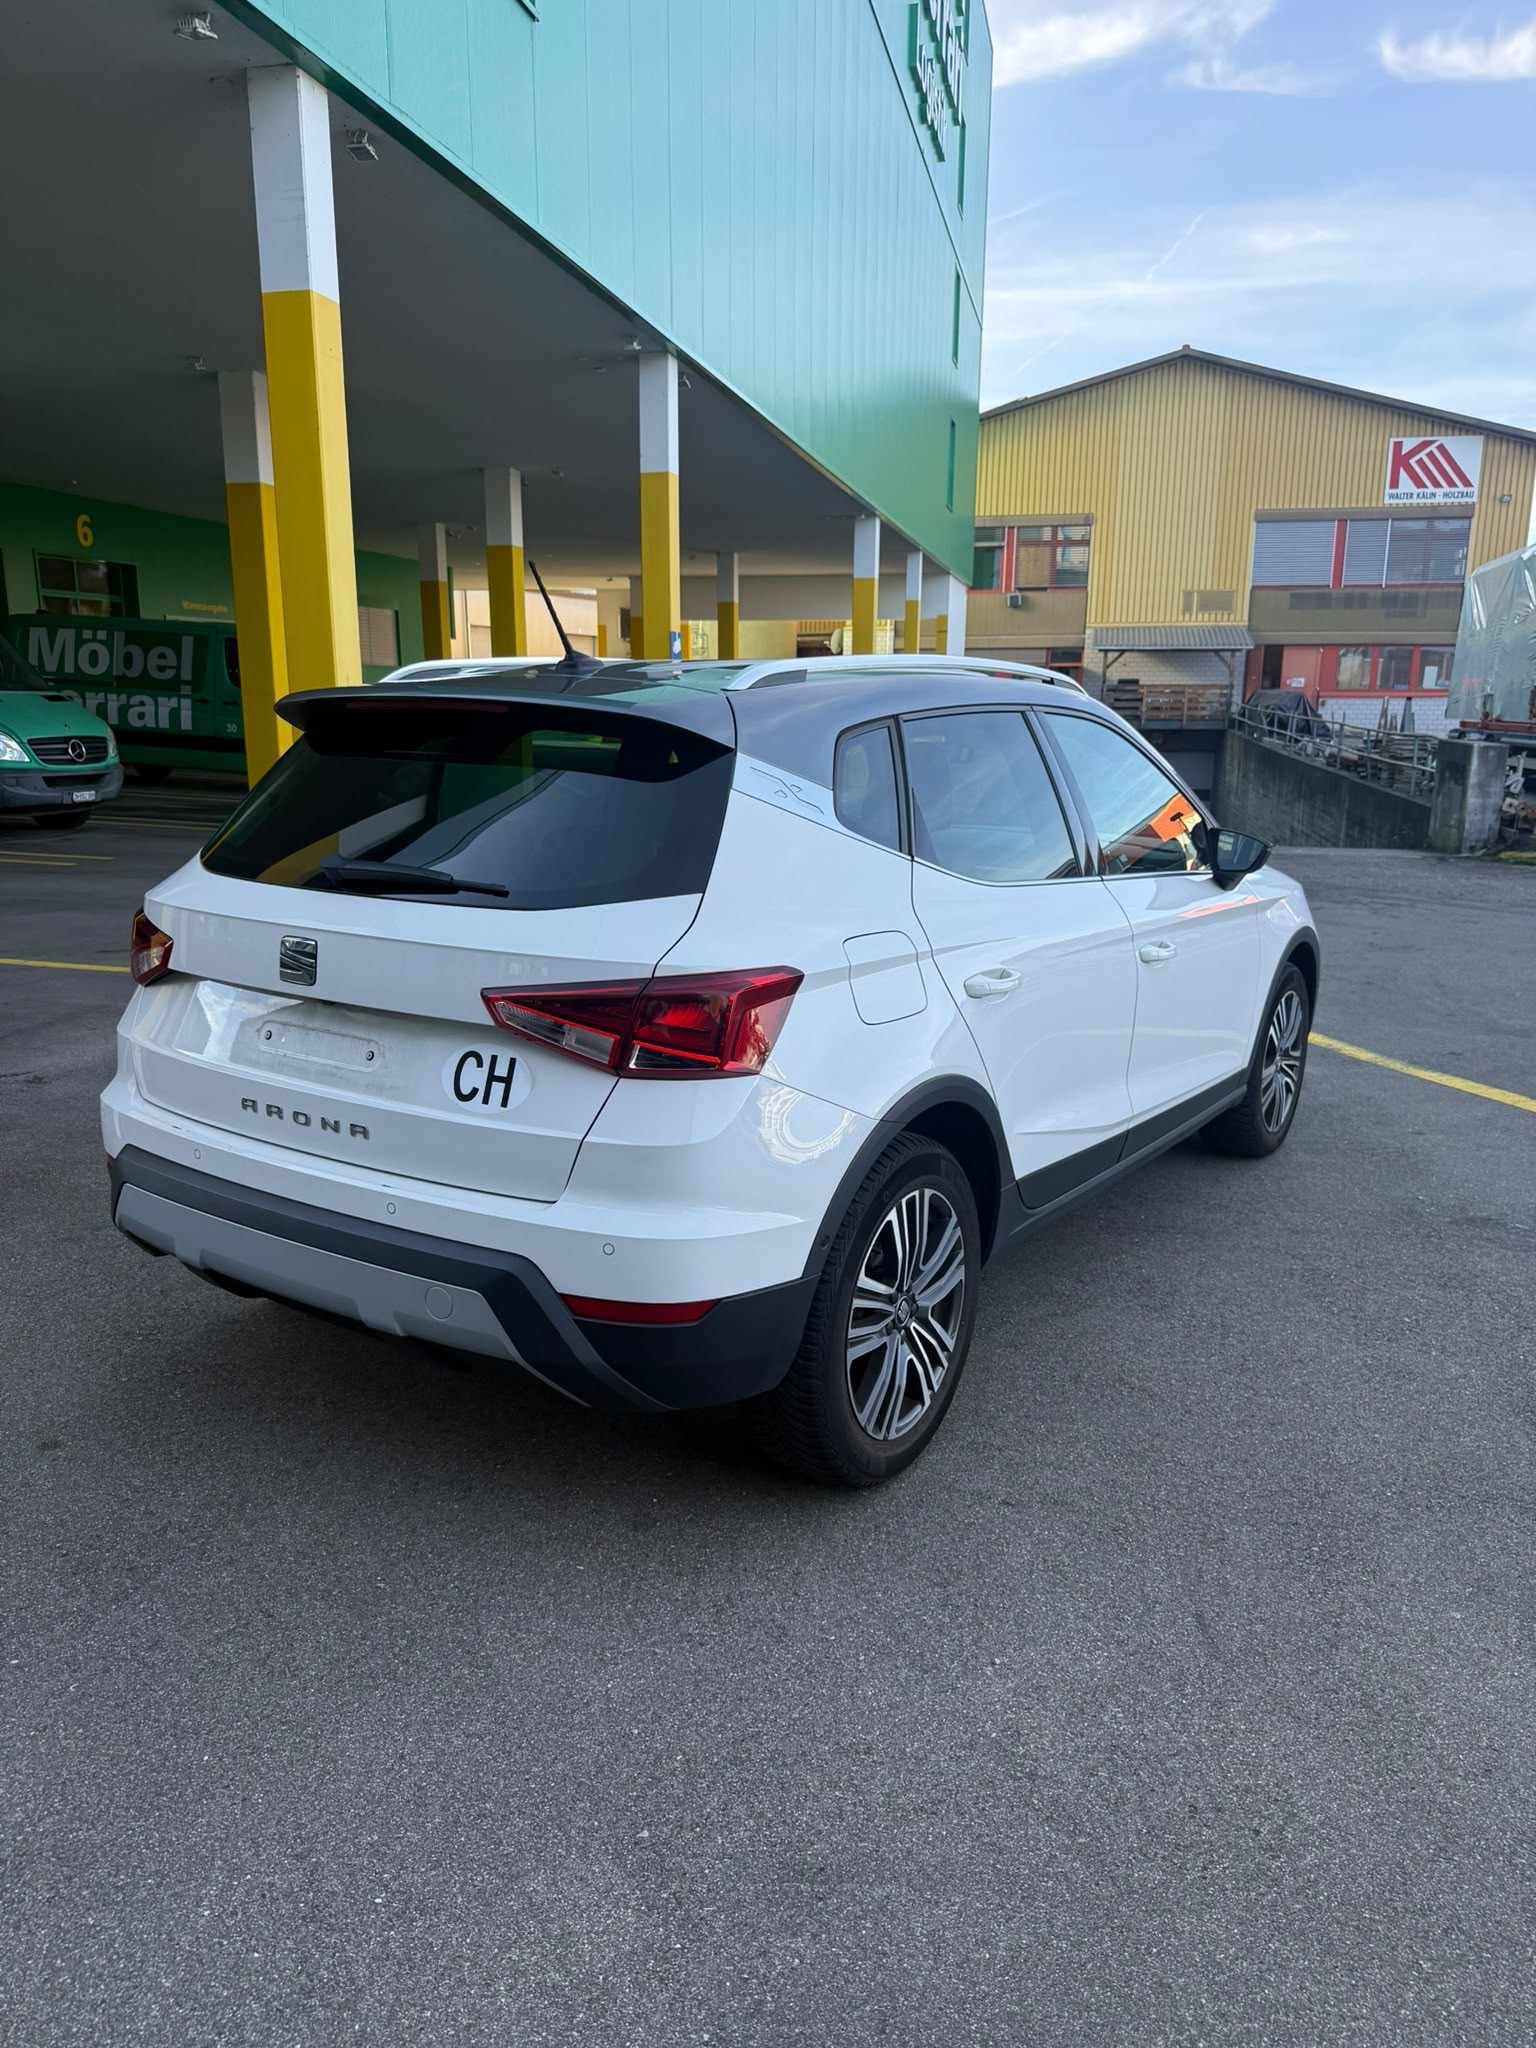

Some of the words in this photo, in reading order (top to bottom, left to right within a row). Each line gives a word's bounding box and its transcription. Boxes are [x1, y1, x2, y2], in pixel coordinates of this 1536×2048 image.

[1388, 492, 1414, 501] WALTER
[1416, 491, 1437, 500] KÄLIN
[1442, 490, 1475, 499] HOLZBAU
[76, 514, 94, 547] 6
[28, 626, 194, 681] Möbel
[43, 676, 193, 730] rrari
[226, 723, 238, 733] 30
[452, 1050, 517, 1108] CH
[241, 1096, 370, 1140] ARONA
